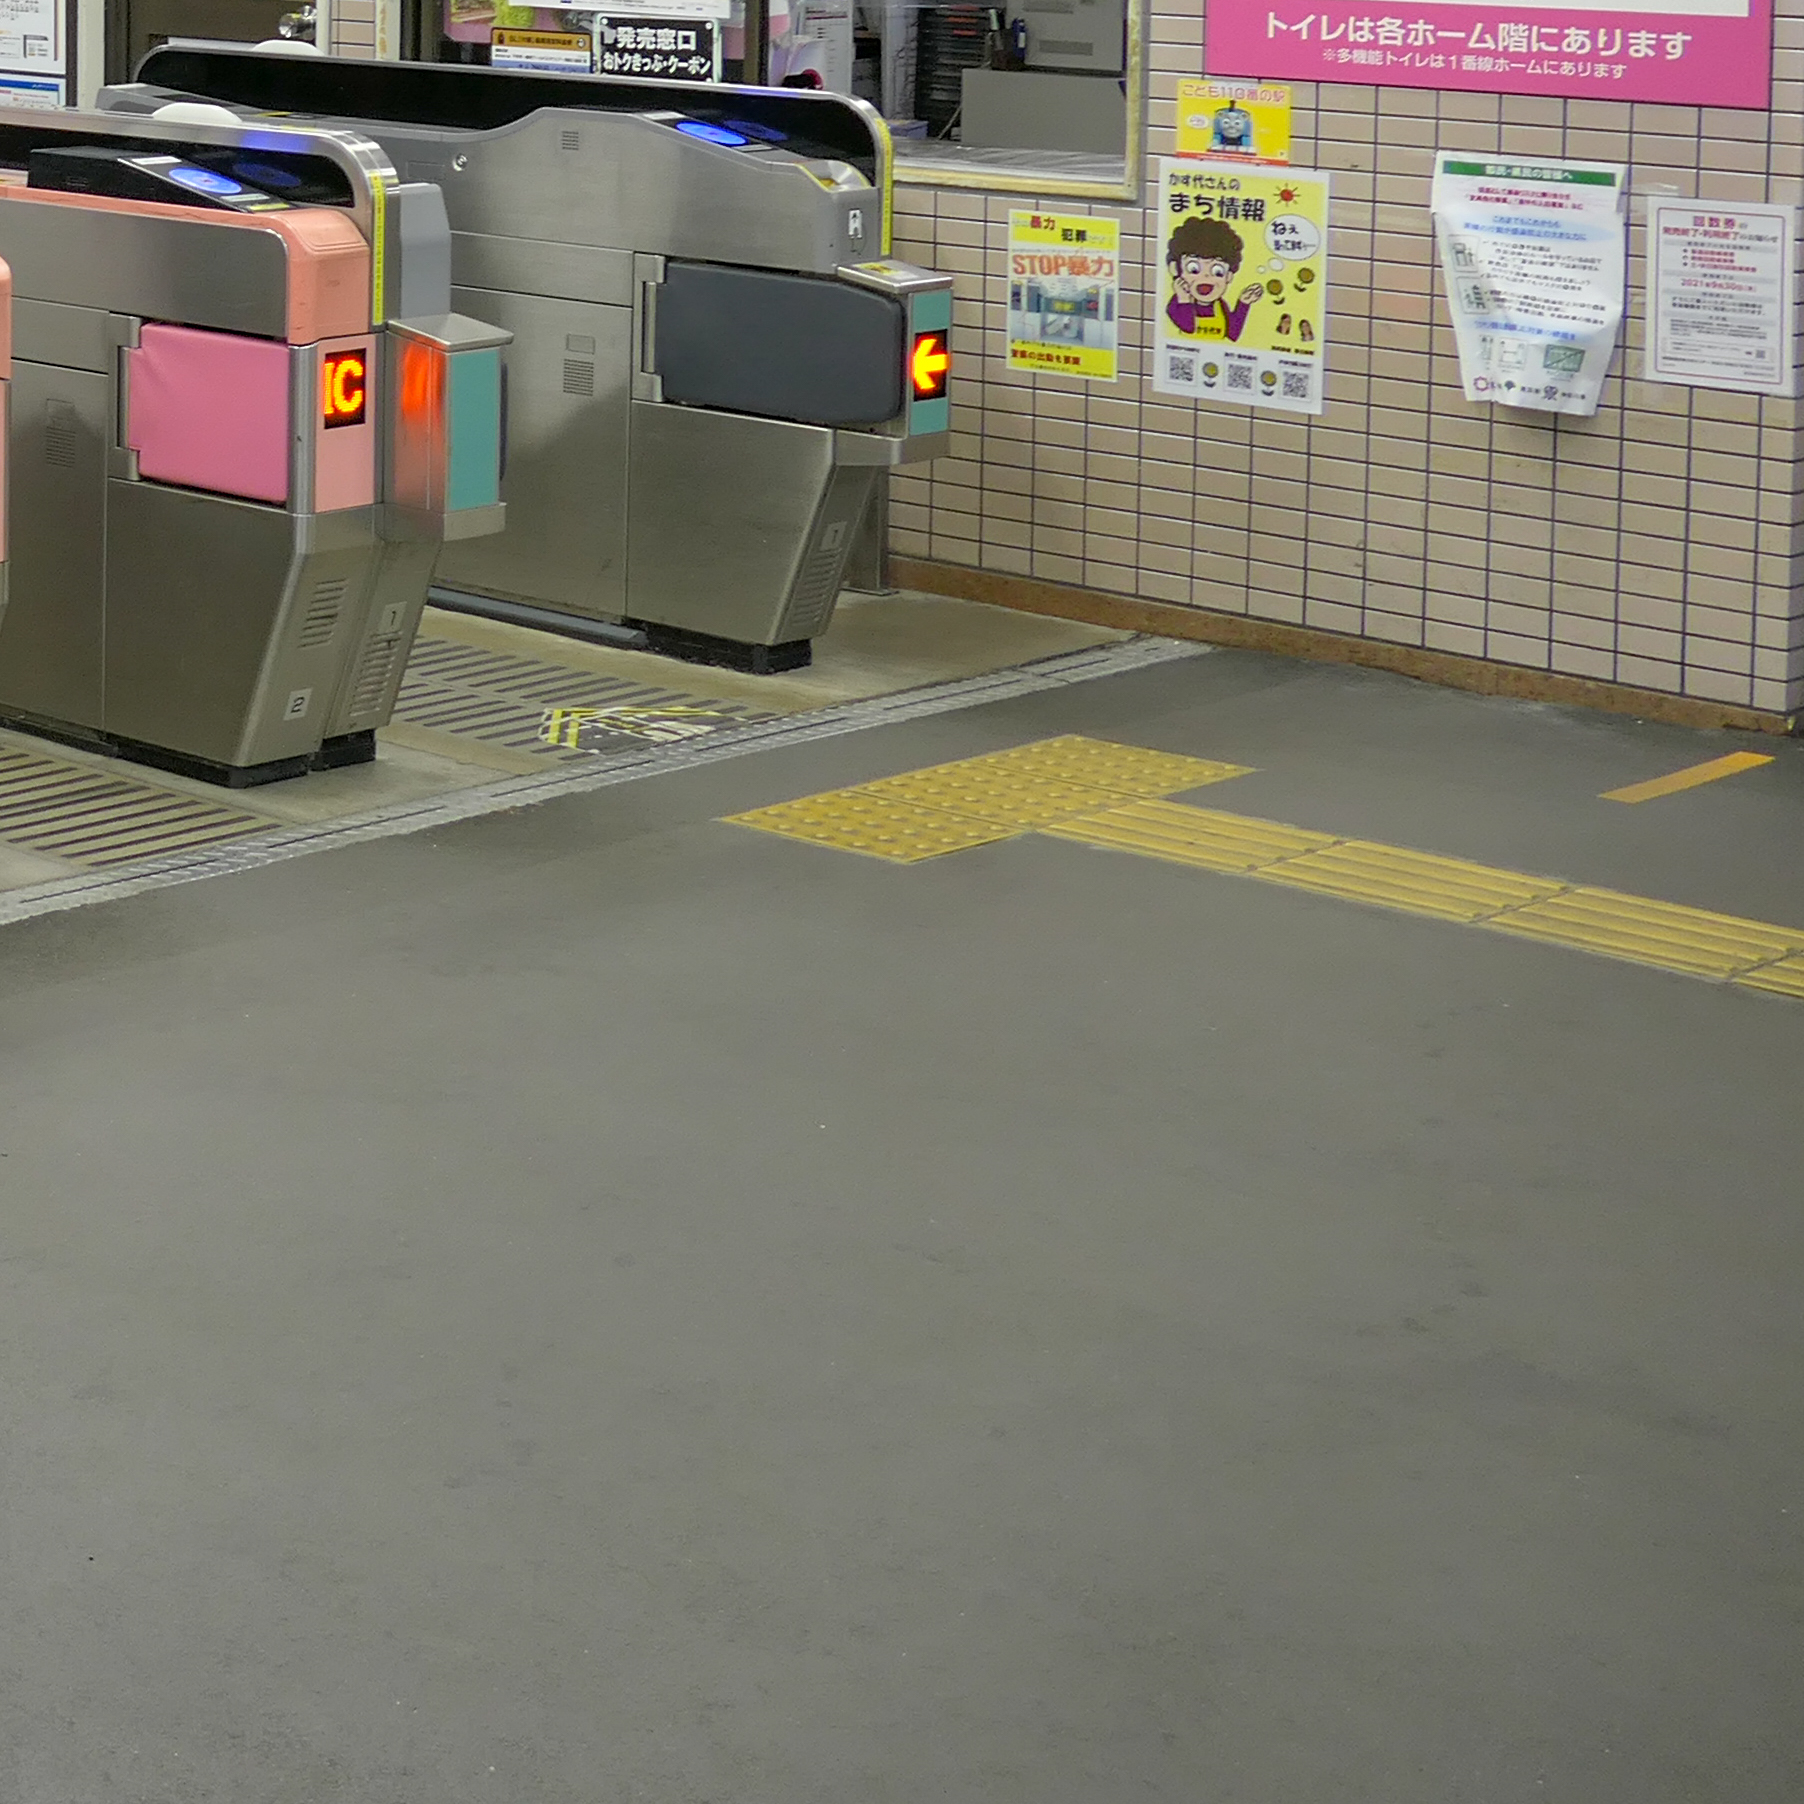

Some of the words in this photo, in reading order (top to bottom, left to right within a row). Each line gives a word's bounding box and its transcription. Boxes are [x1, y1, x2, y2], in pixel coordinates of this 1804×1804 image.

[616, 25, 697, 51] 発売窓口
[1265, 10, 1693, 63] トイレは各ホーム階にあります
[1169, 191, 1266, 222] まち情報
[324, 356, 364, 415] IC
[290, 695, 306, 714] 2
